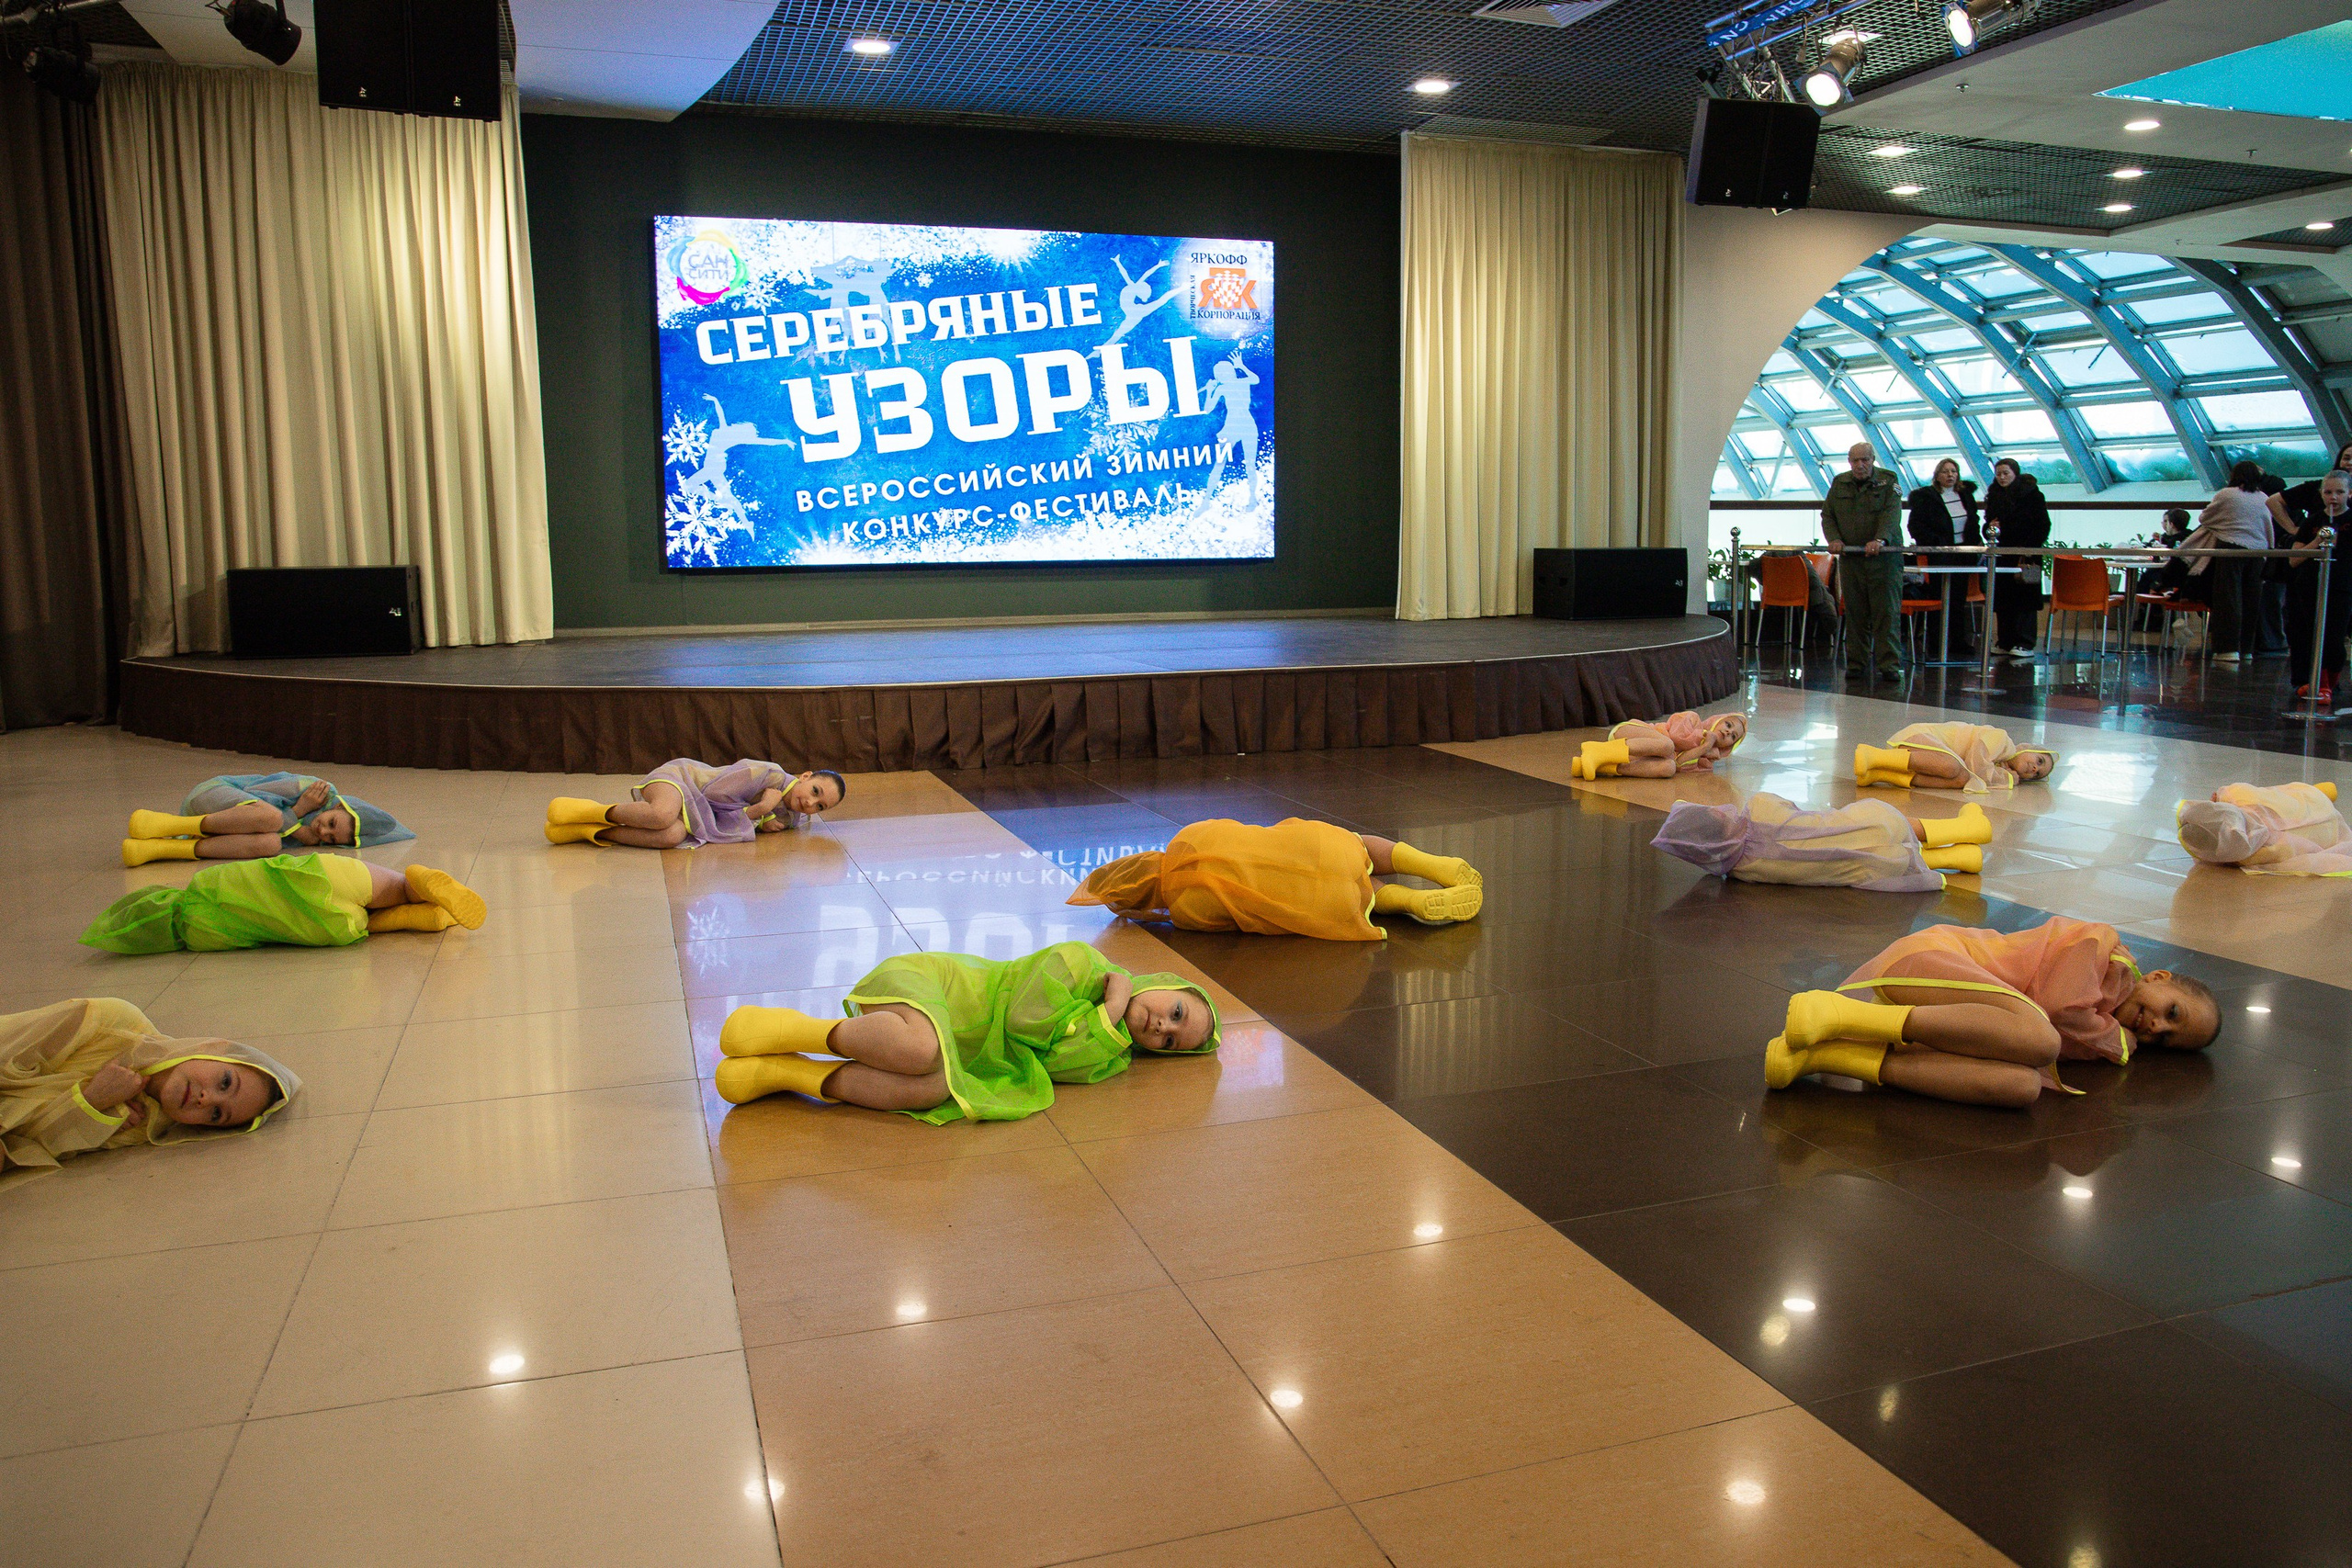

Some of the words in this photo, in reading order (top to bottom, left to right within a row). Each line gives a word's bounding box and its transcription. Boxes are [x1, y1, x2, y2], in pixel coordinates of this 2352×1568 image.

[1191, 253, 1248, 265] ЯРКОФФ
[695, 283, 1102, 365] СЕРЕБРЯНЫЕ
[1197, 310, 1261, 321] КОРПОРАЦИЯ
[780, 335, 1207, 462] УЗОРЫ
[796, 453, 1092, 512] ВСЕРОССИЙСКИЙ
[1107, 438, 1233, 476] ЗИМНИЙ
[842, 482, 1193, 543] КОНКУРС-ФЕСТИВАЛЬ
